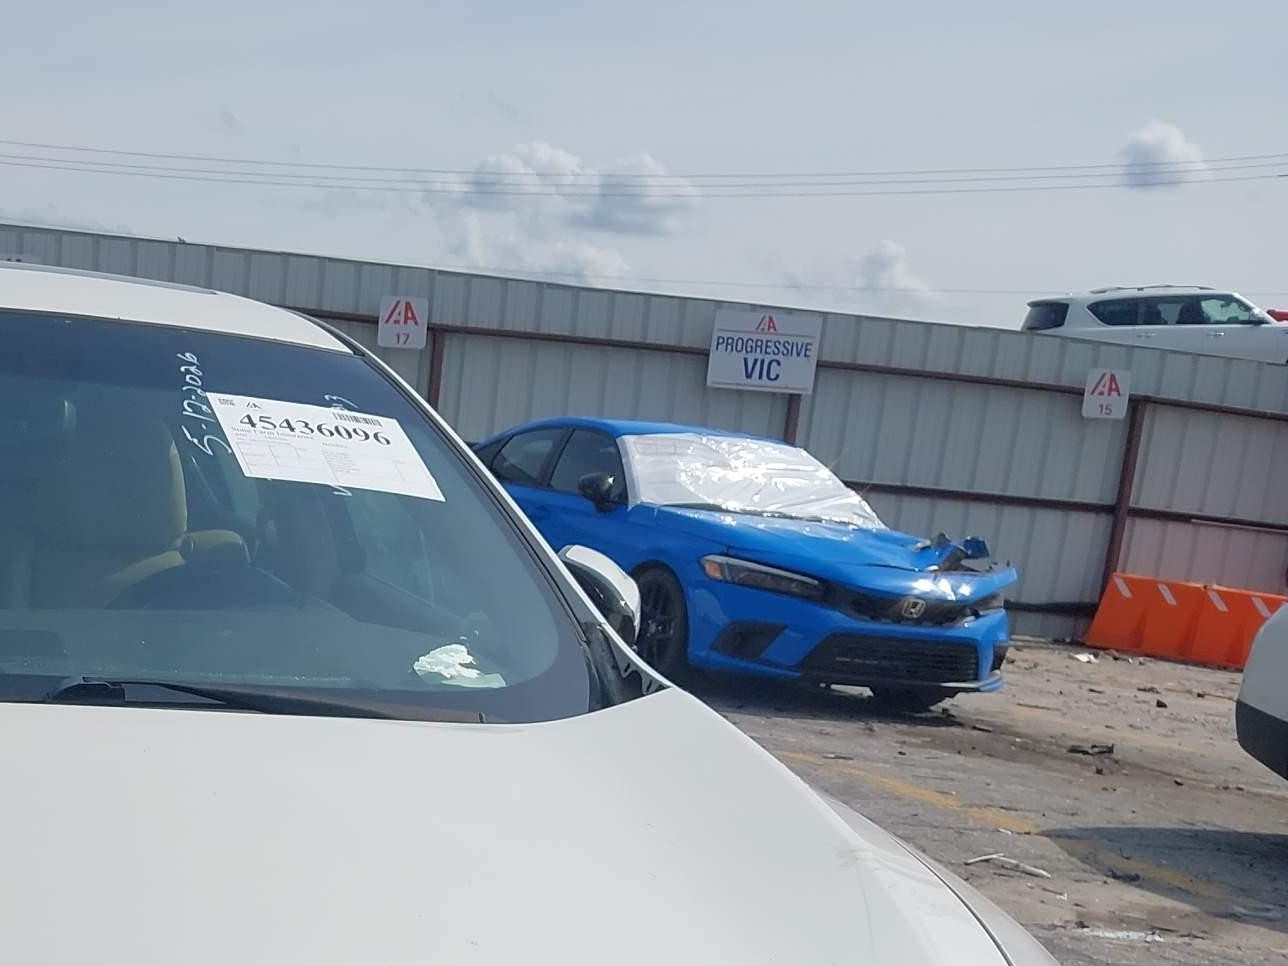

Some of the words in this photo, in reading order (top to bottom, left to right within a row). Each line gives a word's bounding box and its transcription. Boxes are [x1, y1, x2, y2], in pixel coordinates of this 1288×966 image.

[396, 332, 410, 345] 17
[715, 336, 813, 358] PROGRESSIVE
[743, 357, 781, 382] VIC
[1098, 403, 1113, 416] 15
[239, 413, 392, 446] 45436096
